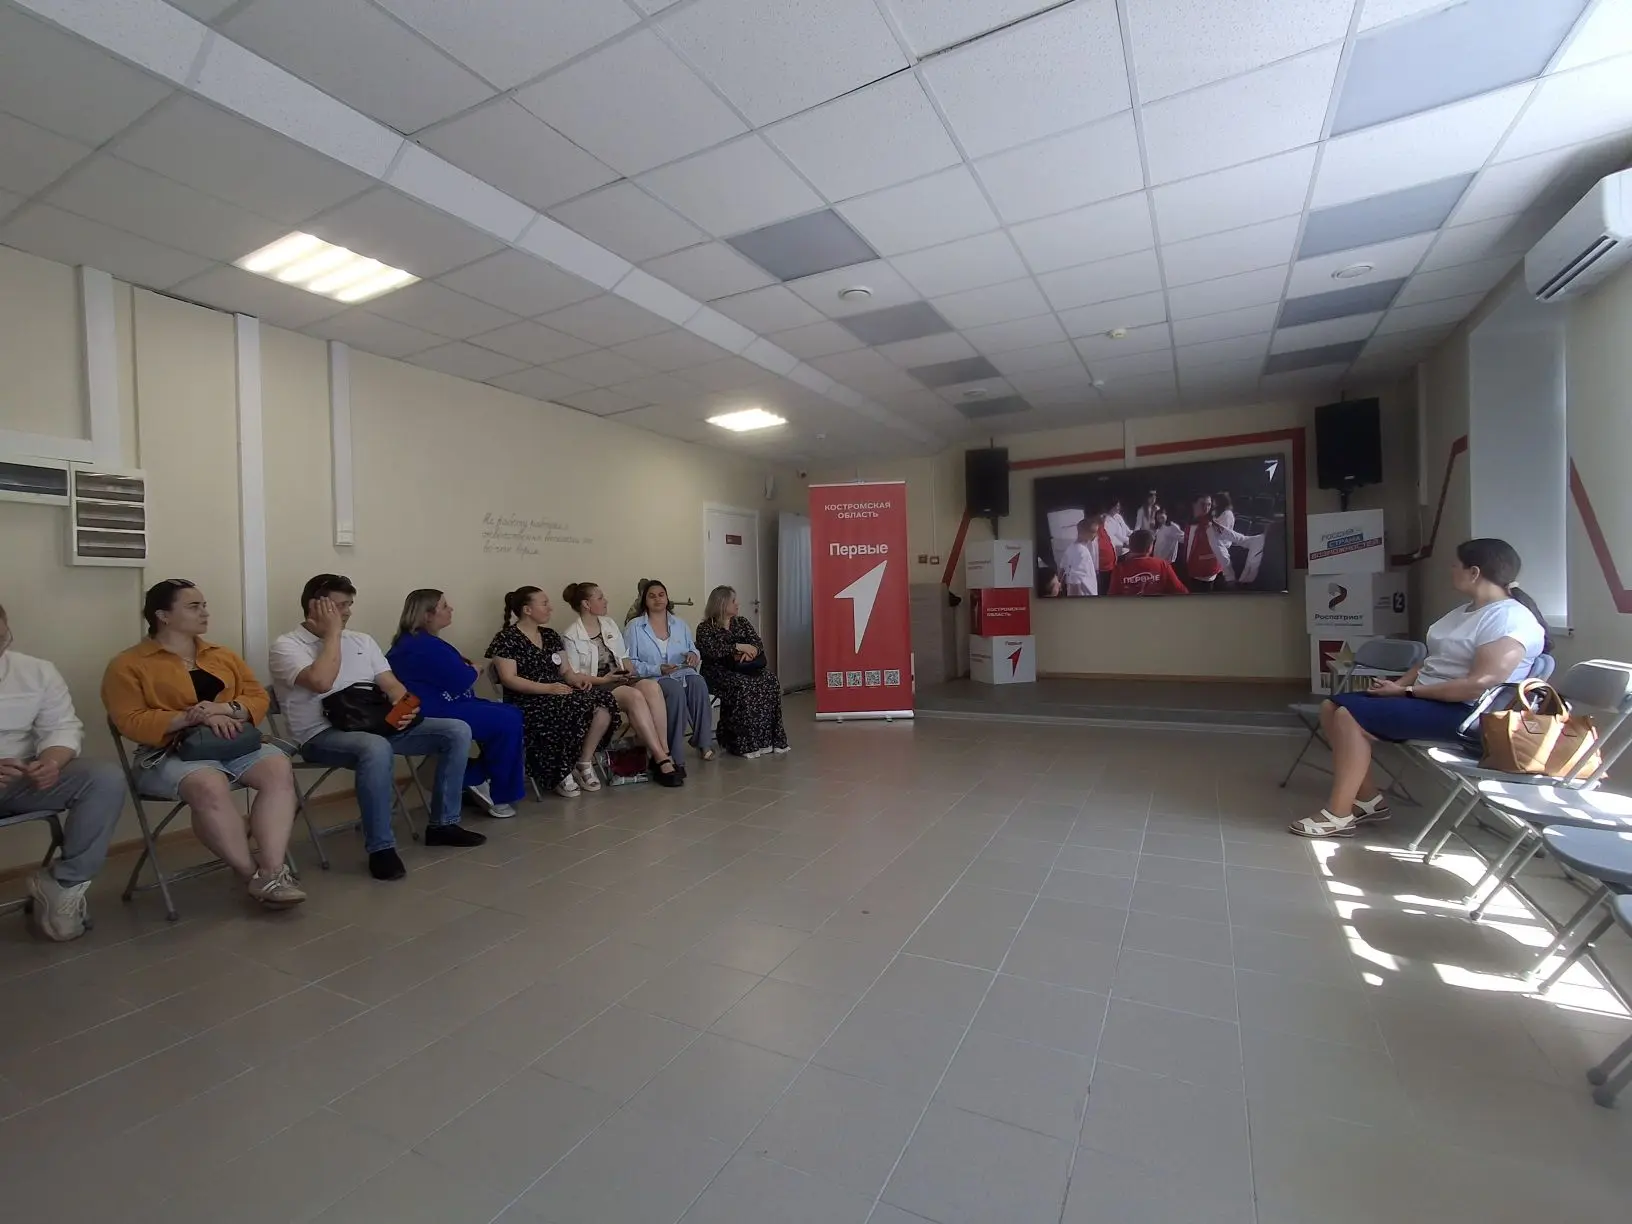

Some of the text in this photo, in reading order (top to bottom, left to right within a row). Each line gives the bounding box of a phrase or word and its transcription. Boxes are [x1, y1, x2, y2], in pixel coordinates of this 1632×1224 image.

[824, 501, 891, 511] КОСТРОМСКАЯ
[837, 511, 879, 519] ОБЛАСТЬ
[829, 543, 889, 559] Первые
